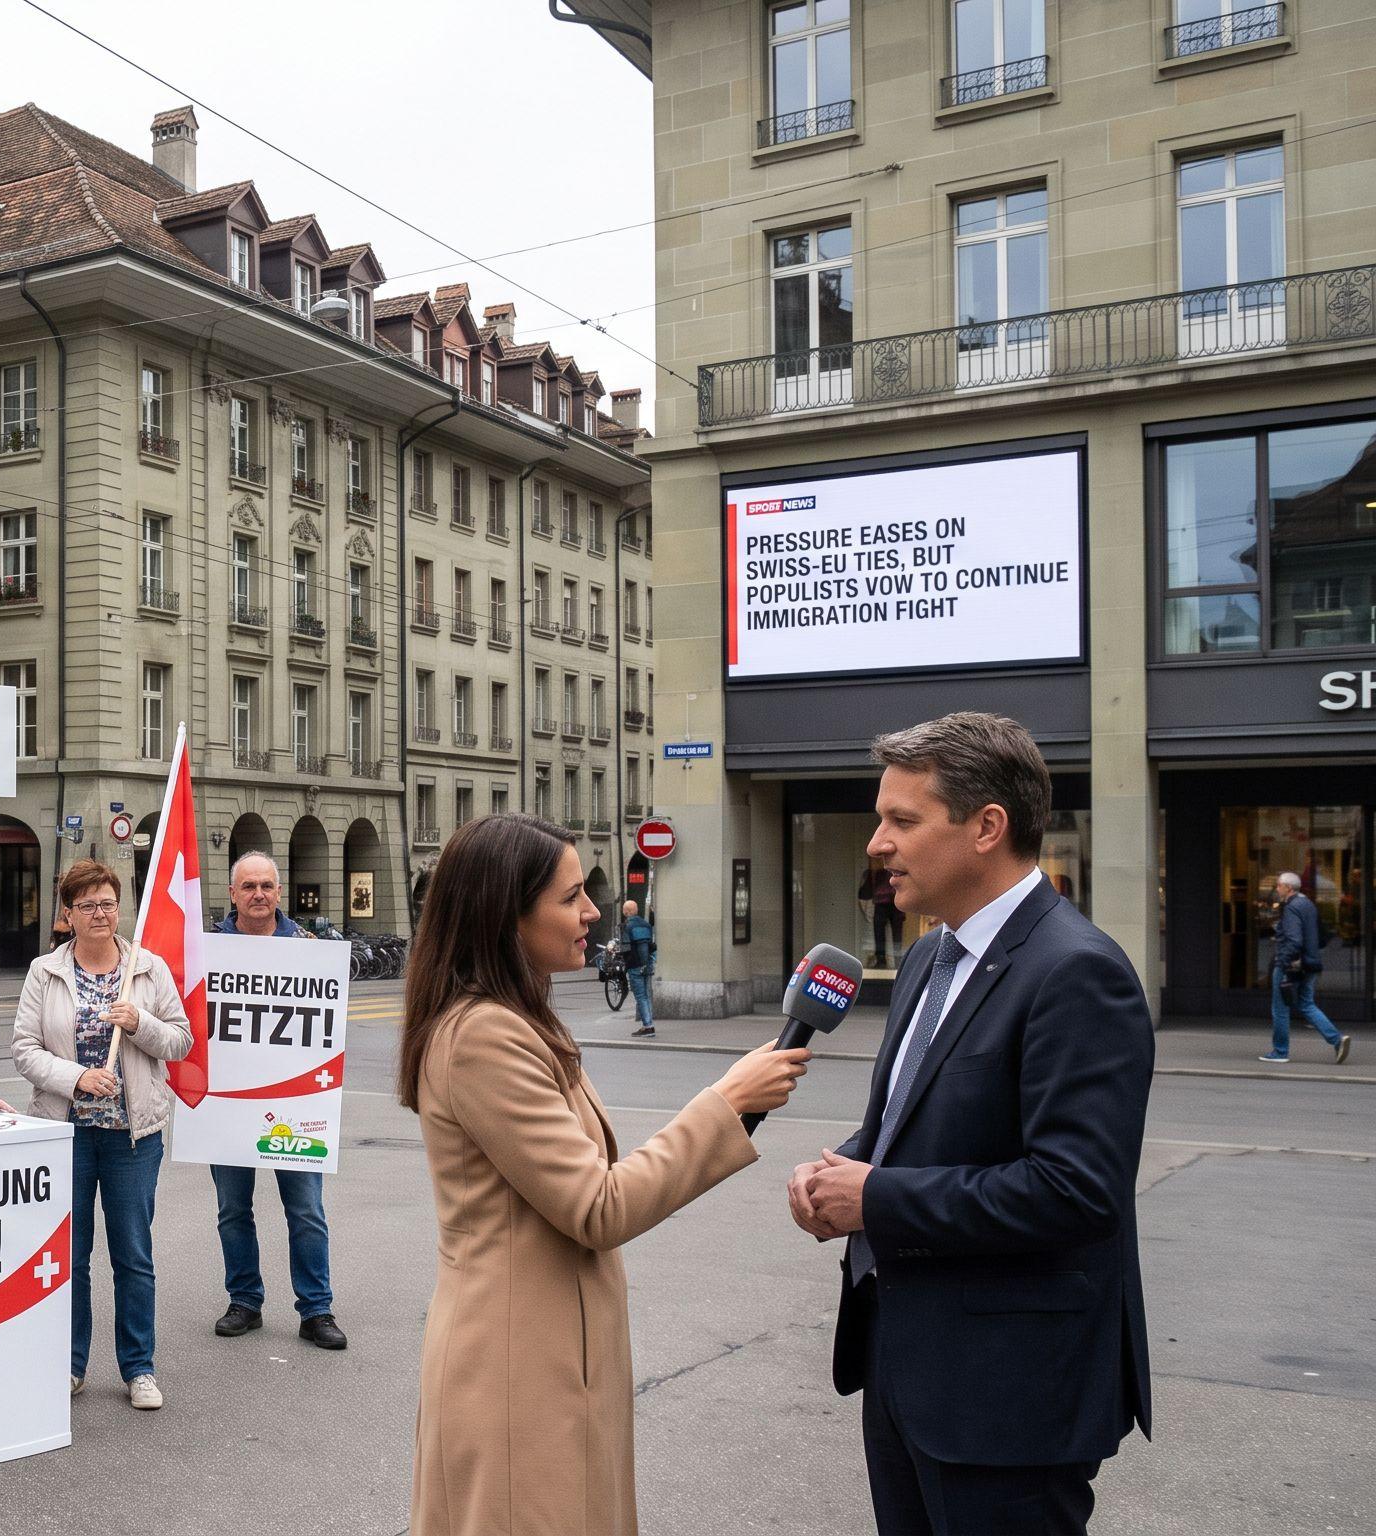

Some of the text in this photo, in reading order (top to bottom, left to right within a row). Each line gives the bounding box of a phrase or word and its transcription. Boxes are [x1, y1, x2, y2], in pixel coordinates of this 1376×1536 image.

[783, 498, 814, 510] NEWS
[746, 517, 966, 554] PRESSURE EASES ON
[746, 544, 954, 581] SWISS-EU TIES, BUT
[746, 561, 1069, 605] POPULISTS VOW TO CONTINUE
[746, 597, 958, 631] IMMIGRATION FIGHT
[208, 972, 339, 1000] EGRENZUNG
[807, 982, 848, 1009] NEWS
[268, 1136, 312, 1152] SVP
